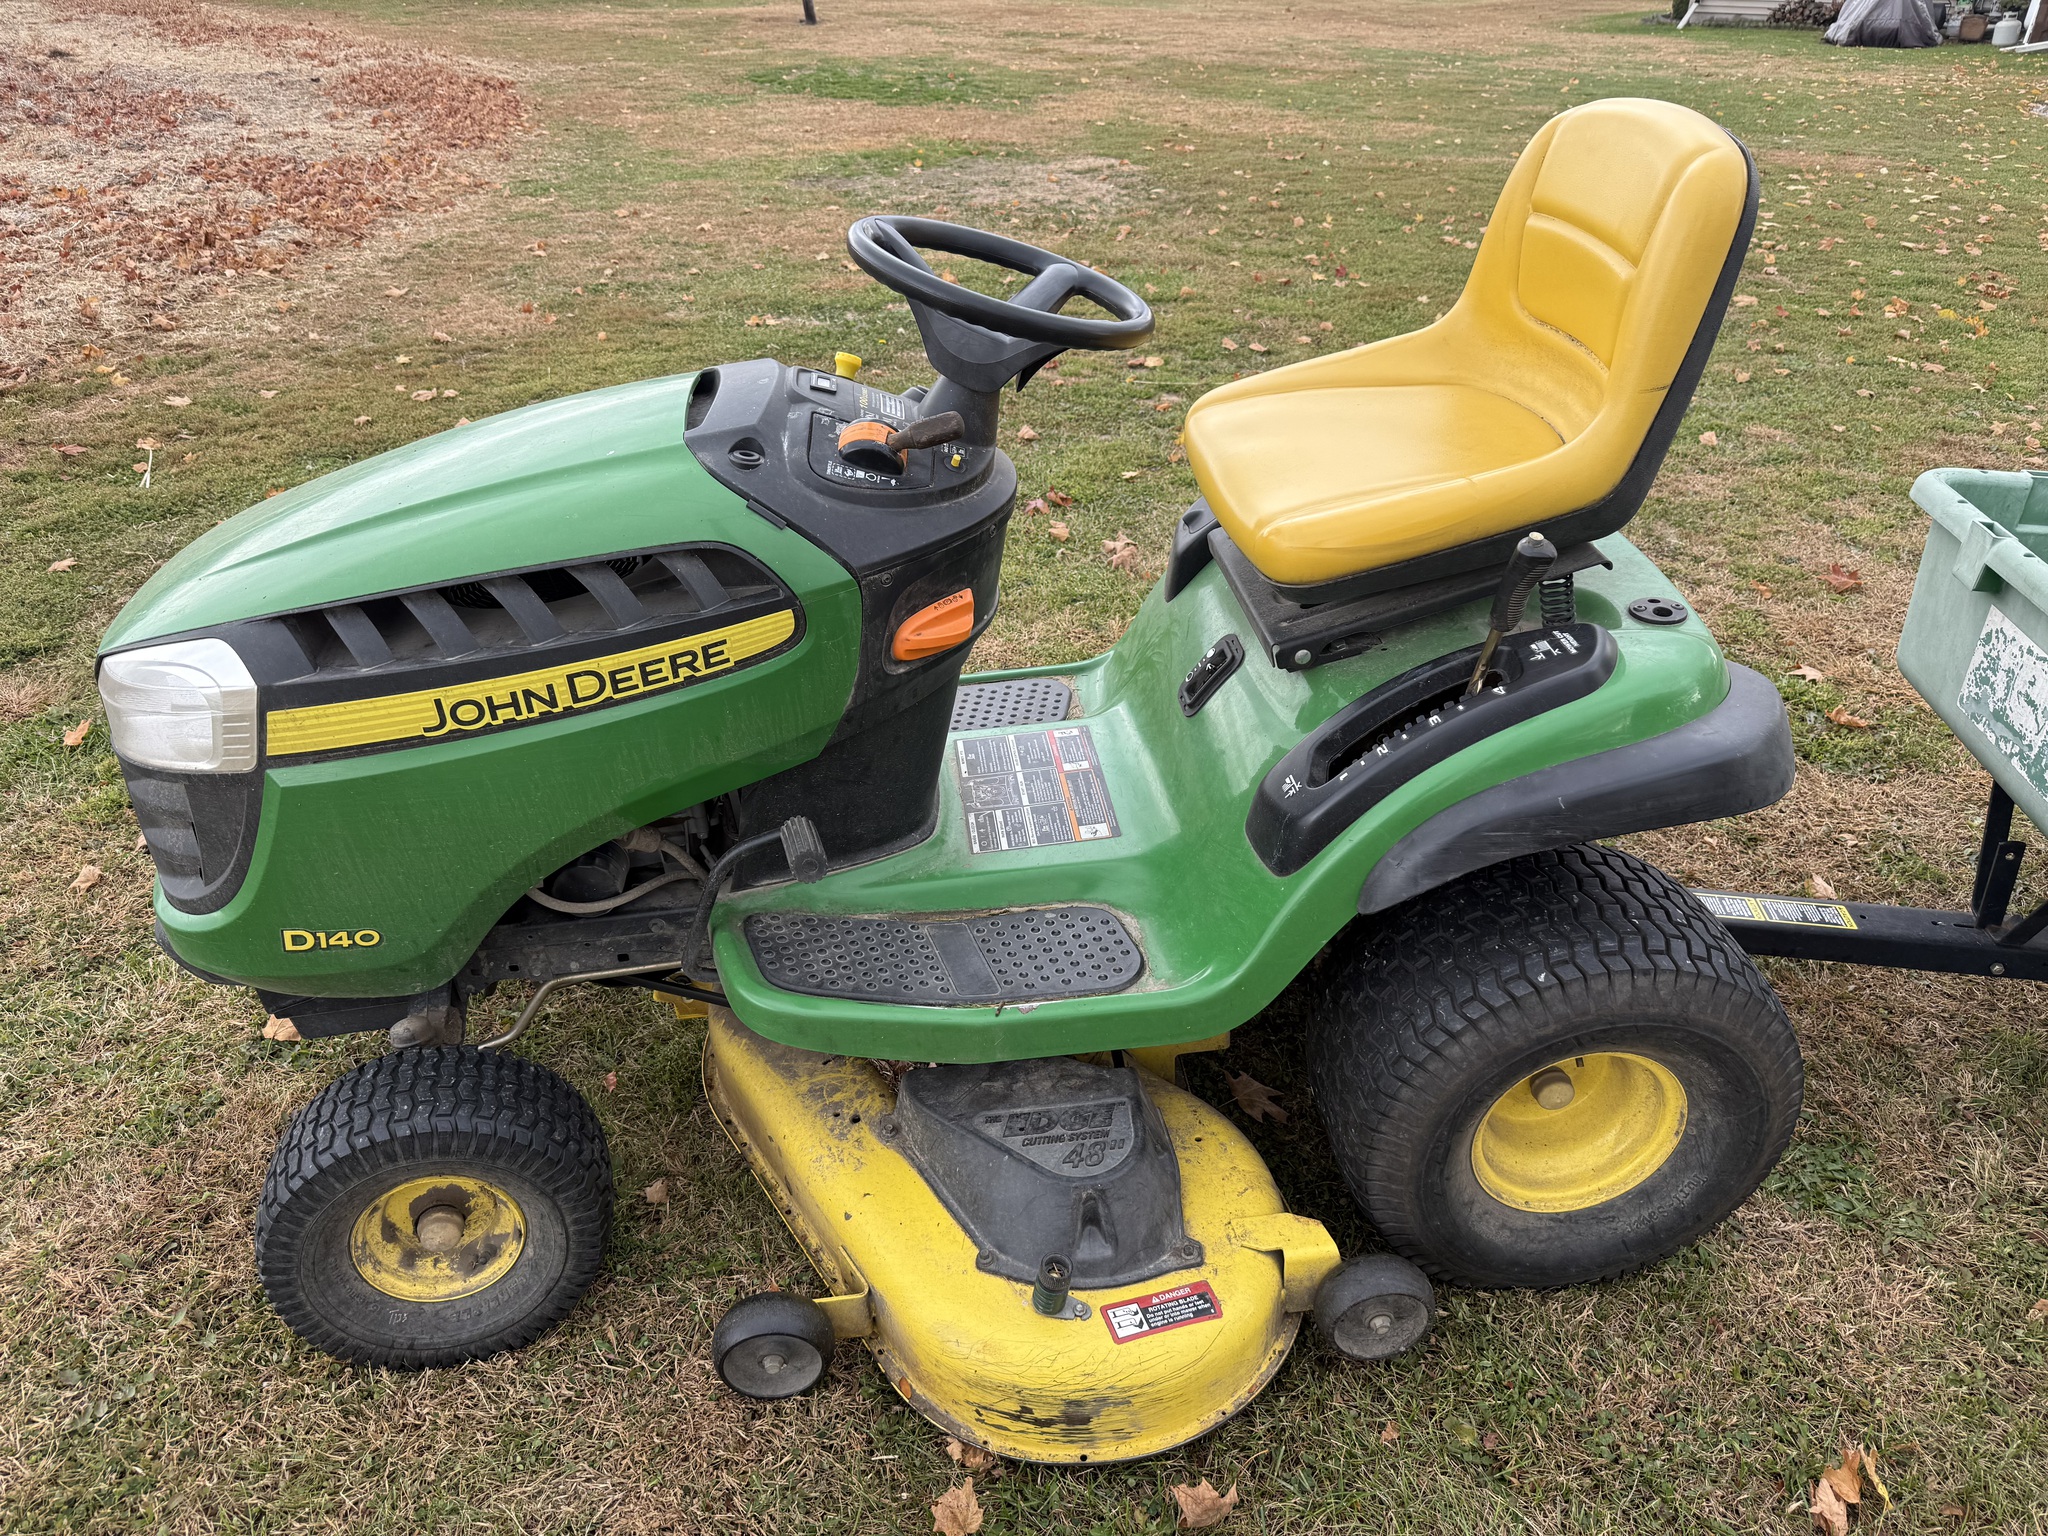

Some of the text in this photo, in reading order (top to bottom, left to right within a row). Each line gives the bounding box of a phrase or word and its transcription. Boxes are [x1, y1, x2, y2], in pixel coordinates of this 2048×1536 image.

[422, 638, 731, 733] JOHN DEERE
[1376, 744, 1390, 756] 2
[1428, 714, 1442, 726] 3
[1492, 685, 1506, 696] 4
[282, 929, 382, 952] D140
[984, 1115, 1002, 1124] THE
[1022, 1129, 1110, 1147] CUTTING SYSTEM
[1158, 1287, 1191, 1300] DANGER
[1148, 1295, 1198, 1312] ROTATING BLADE
[1164, 1308, 1172, 1316] put
[1172, 1304, 1188, 1312] hands
[1150, 1320, 1167, 1328] engine
[1174, 1312, 1194, 1322] running
